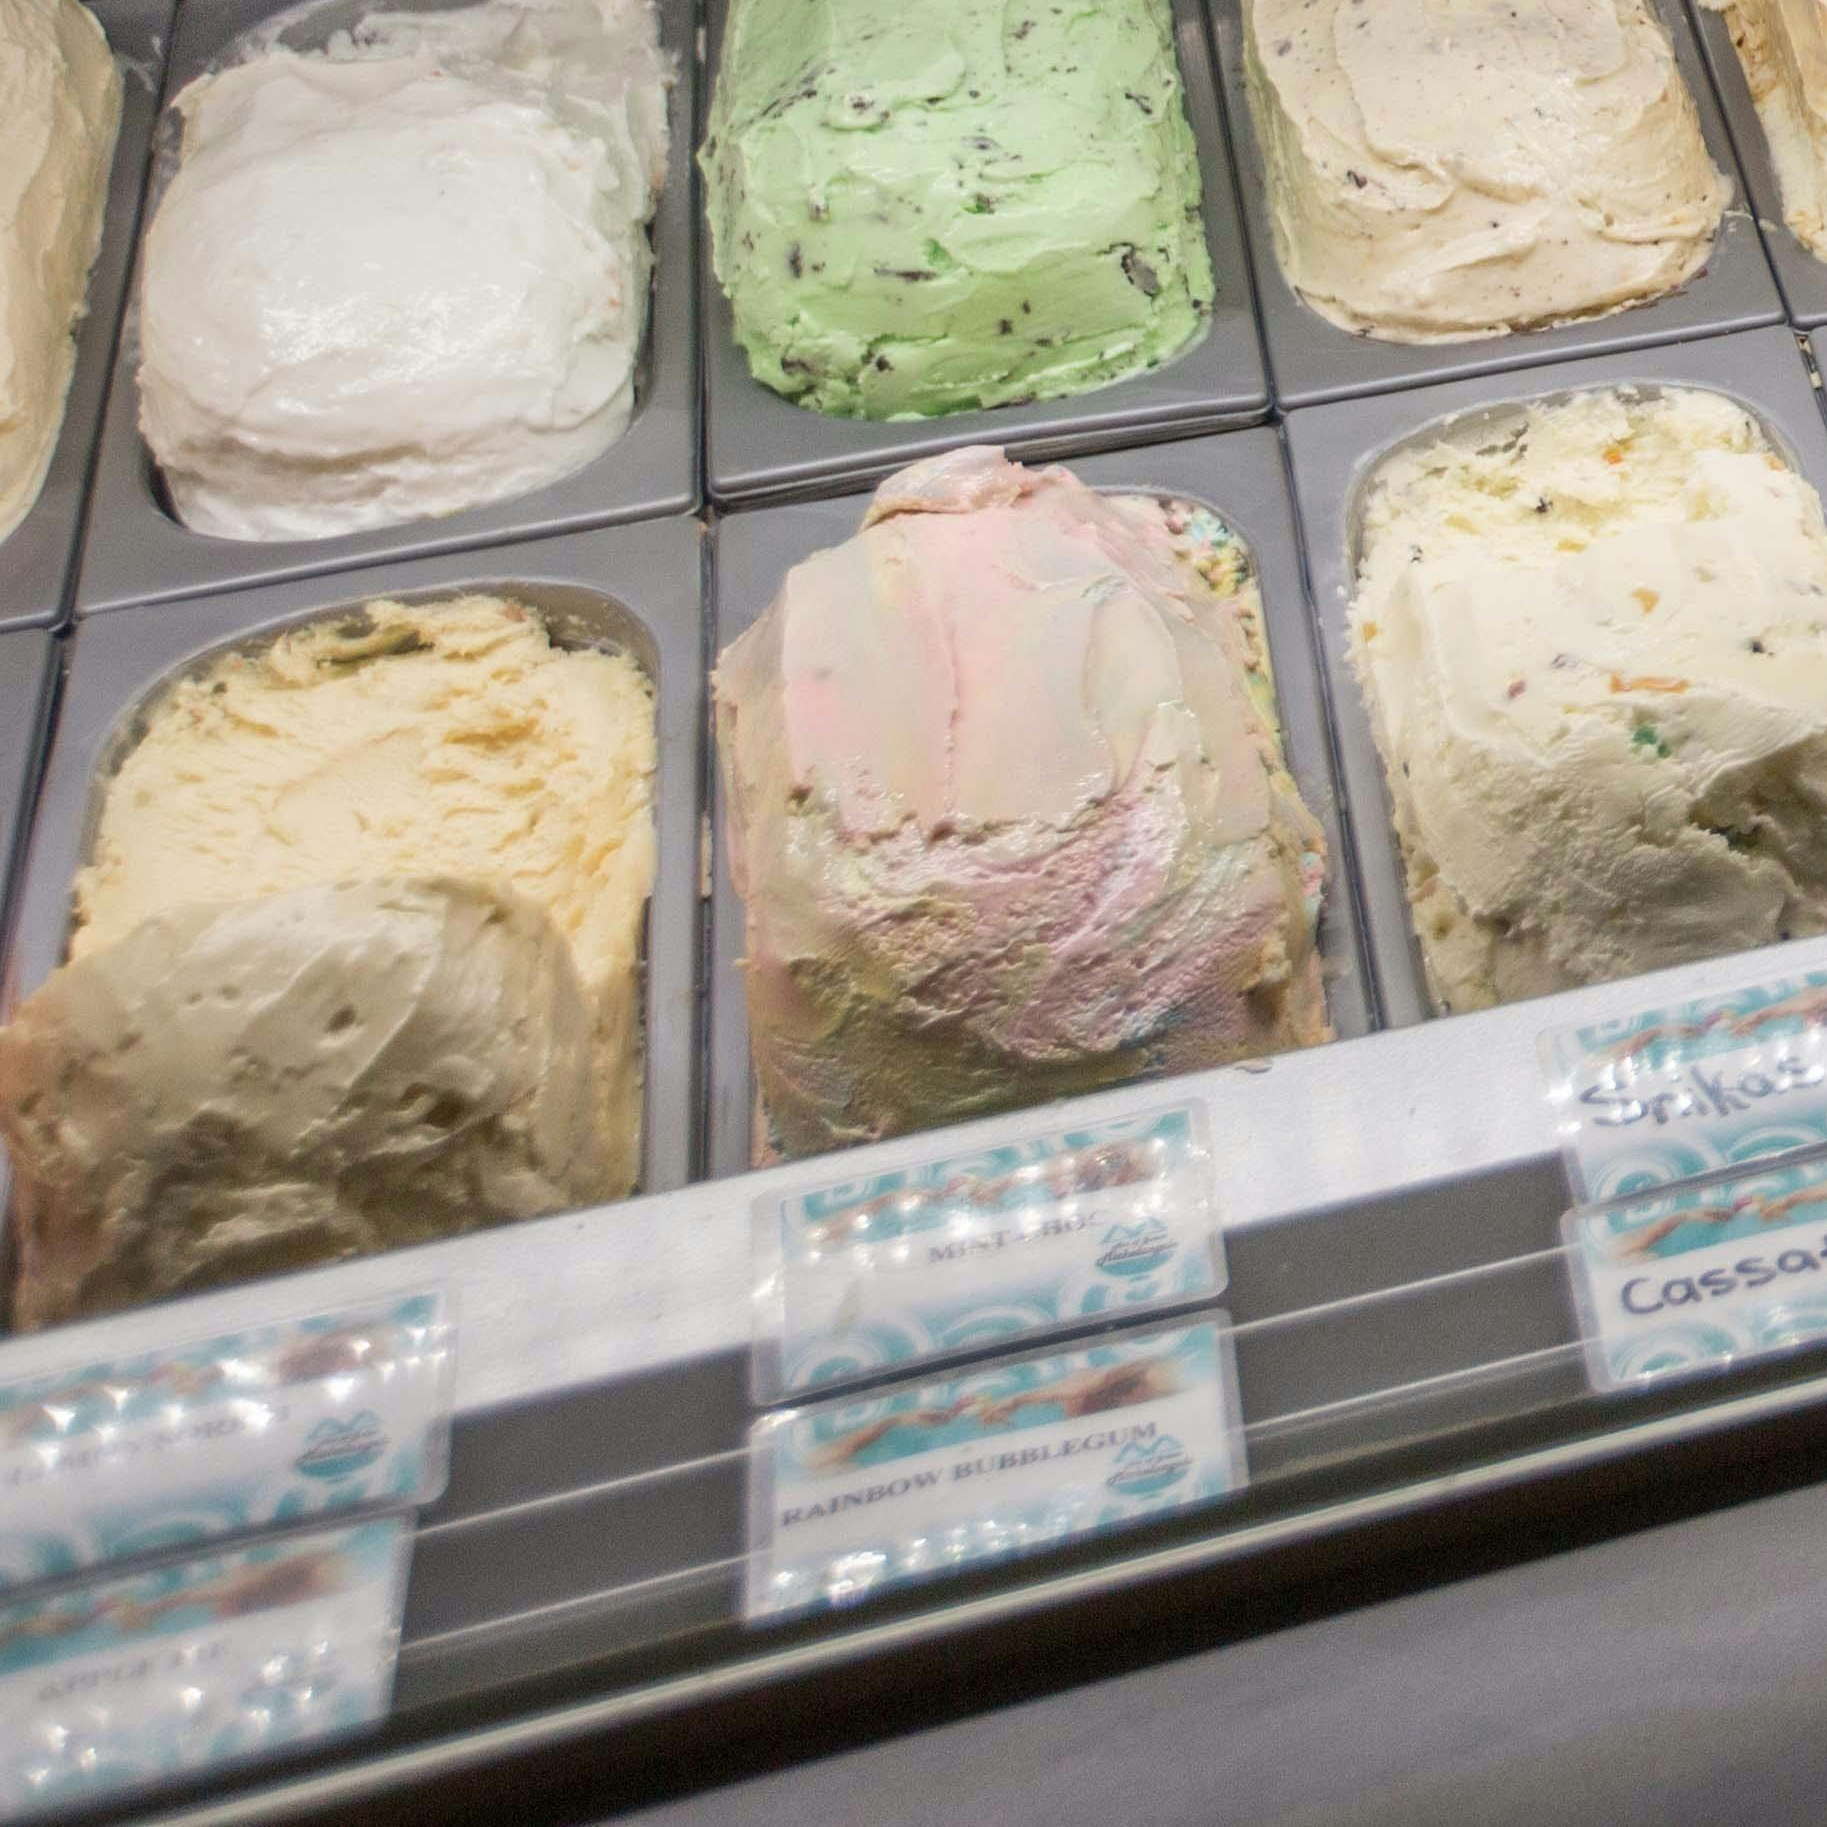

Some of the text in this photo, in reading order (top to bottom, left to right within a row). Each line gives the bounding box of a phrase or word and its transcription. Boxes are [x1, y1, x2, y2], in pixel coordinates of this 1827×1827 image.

[928, 1229, 1010, 1264] MINT
[781, 1467, 945, 1527] RAINBOW
[952, 1421, 1157, 1481] BUBBLEGUM
